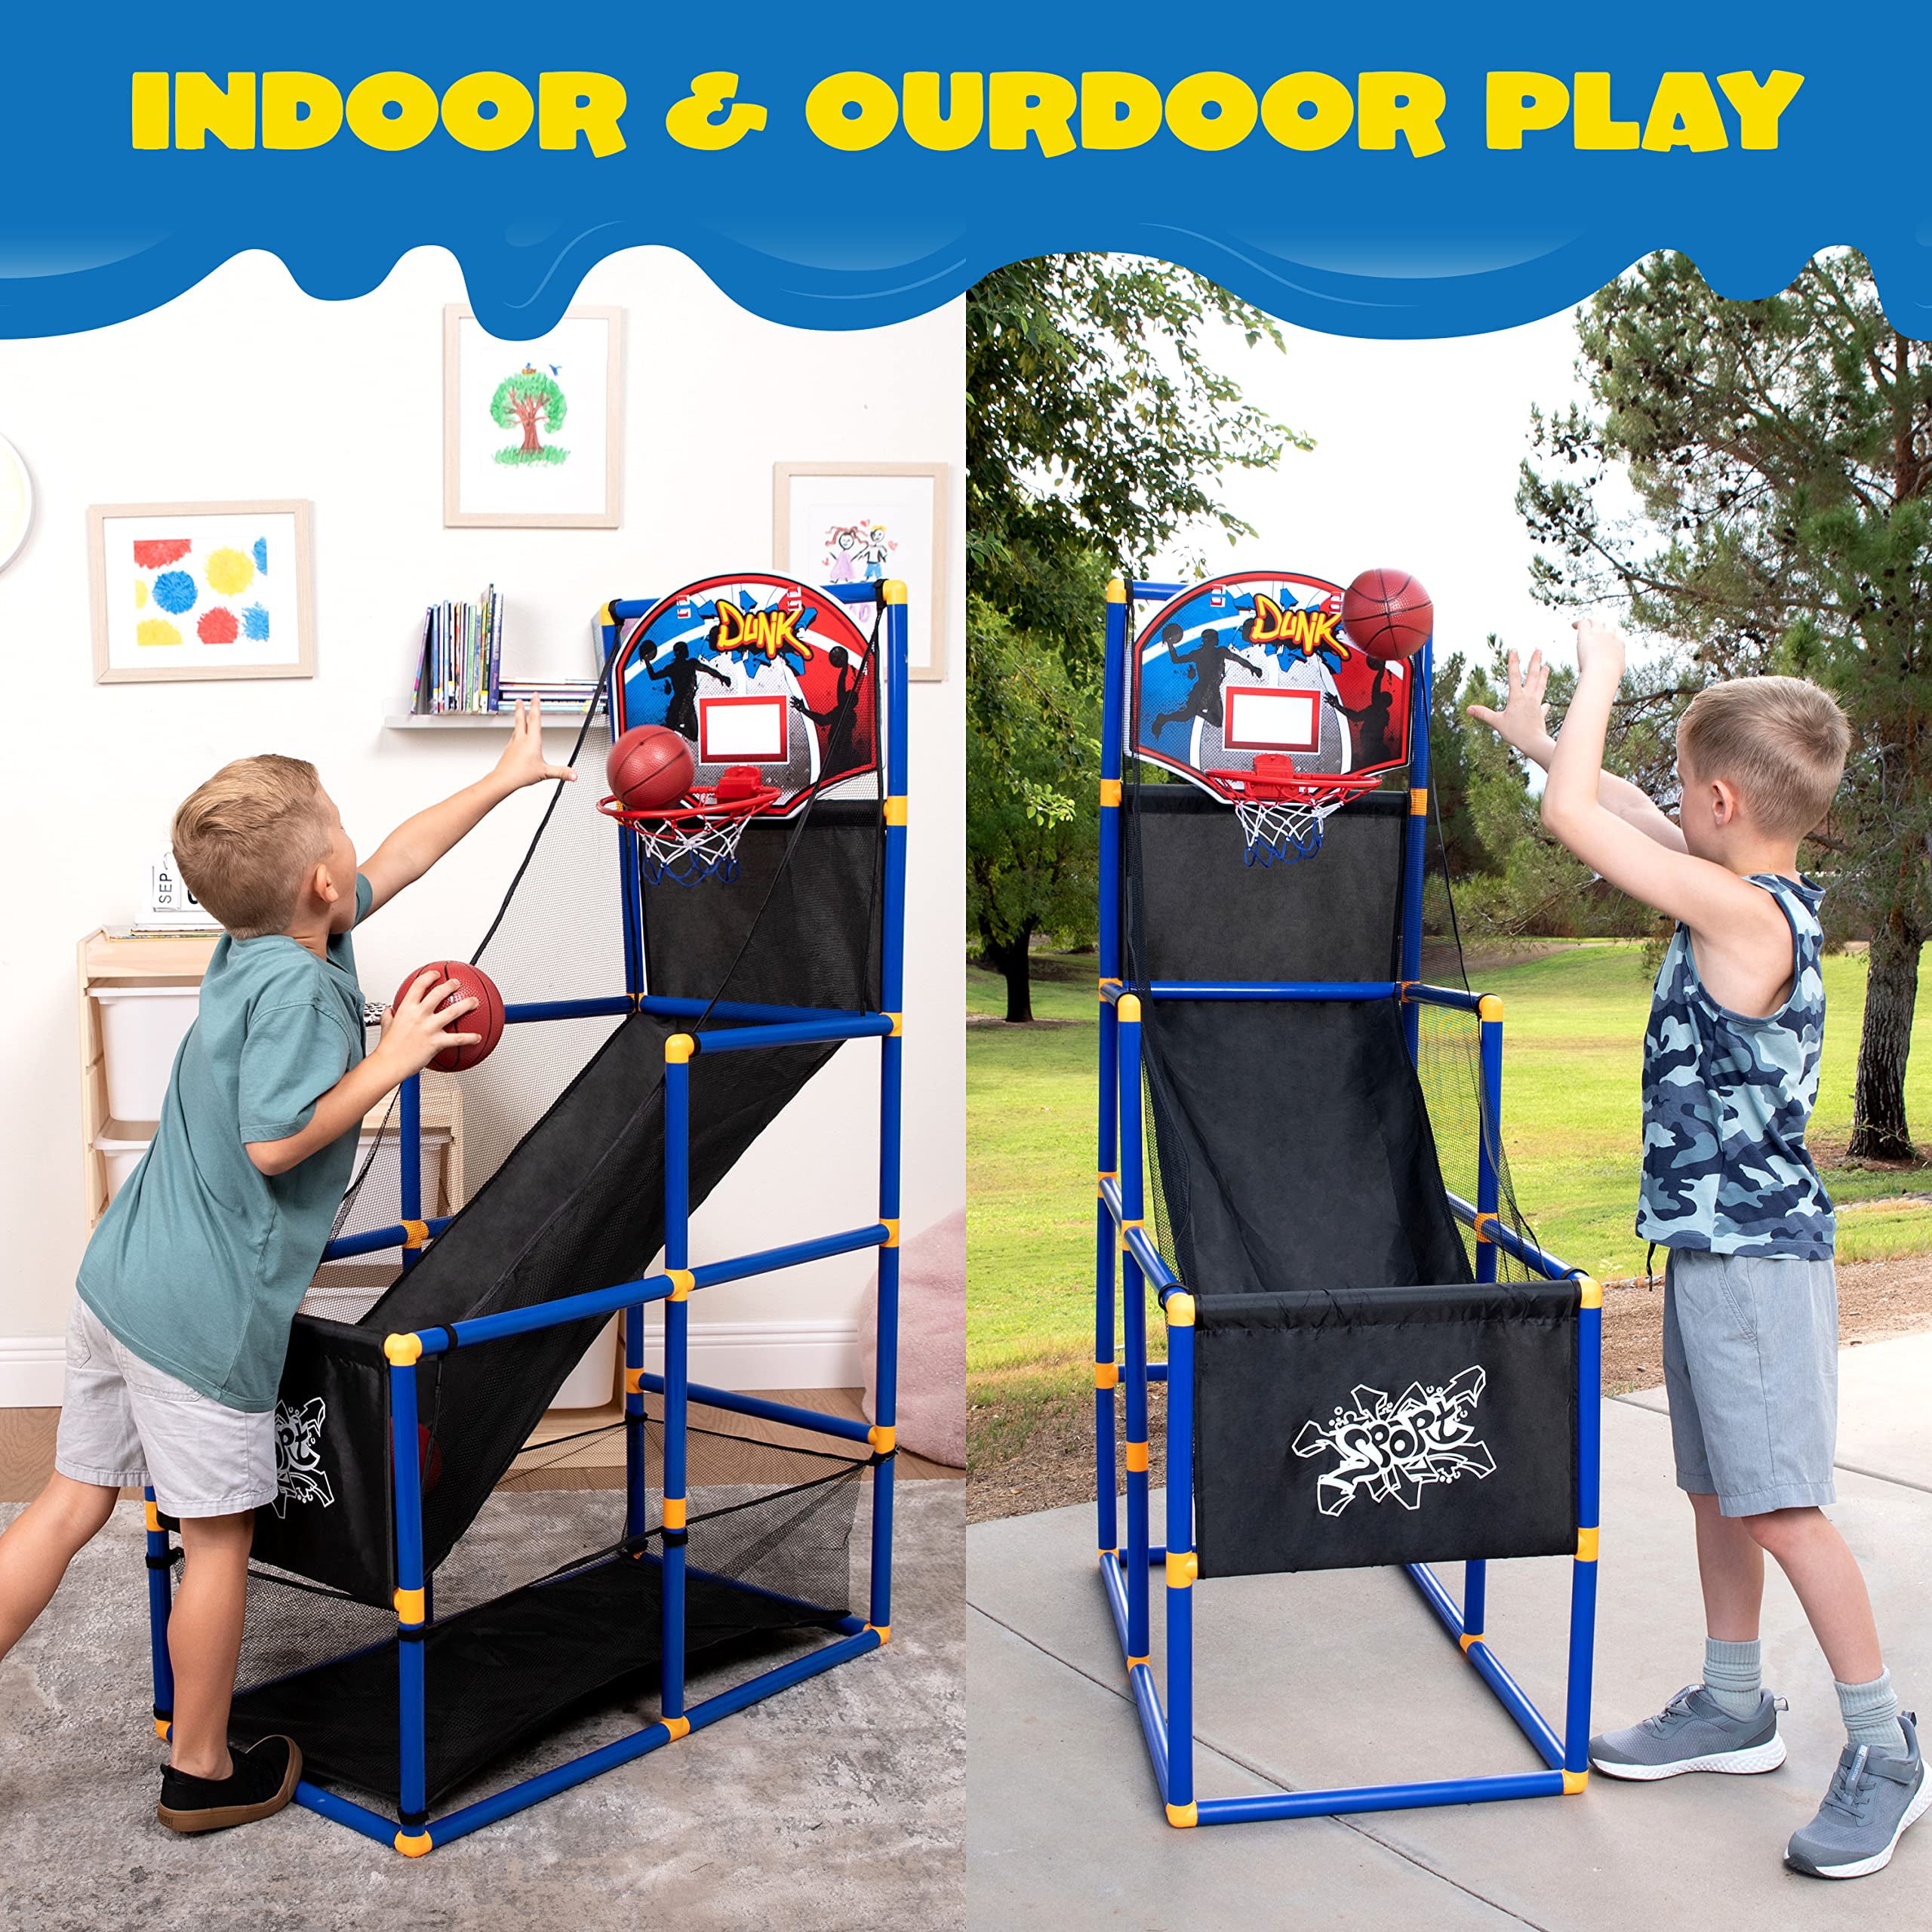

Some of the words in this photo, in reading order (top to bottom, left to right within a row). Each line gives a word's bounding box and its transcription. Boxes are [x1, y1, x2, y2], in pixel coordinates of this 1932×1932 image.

[717, 600, 813, 660] DUNK
[1250, 593, 1351, 660] DUNK
[158, 872, 173, 904] SEP
